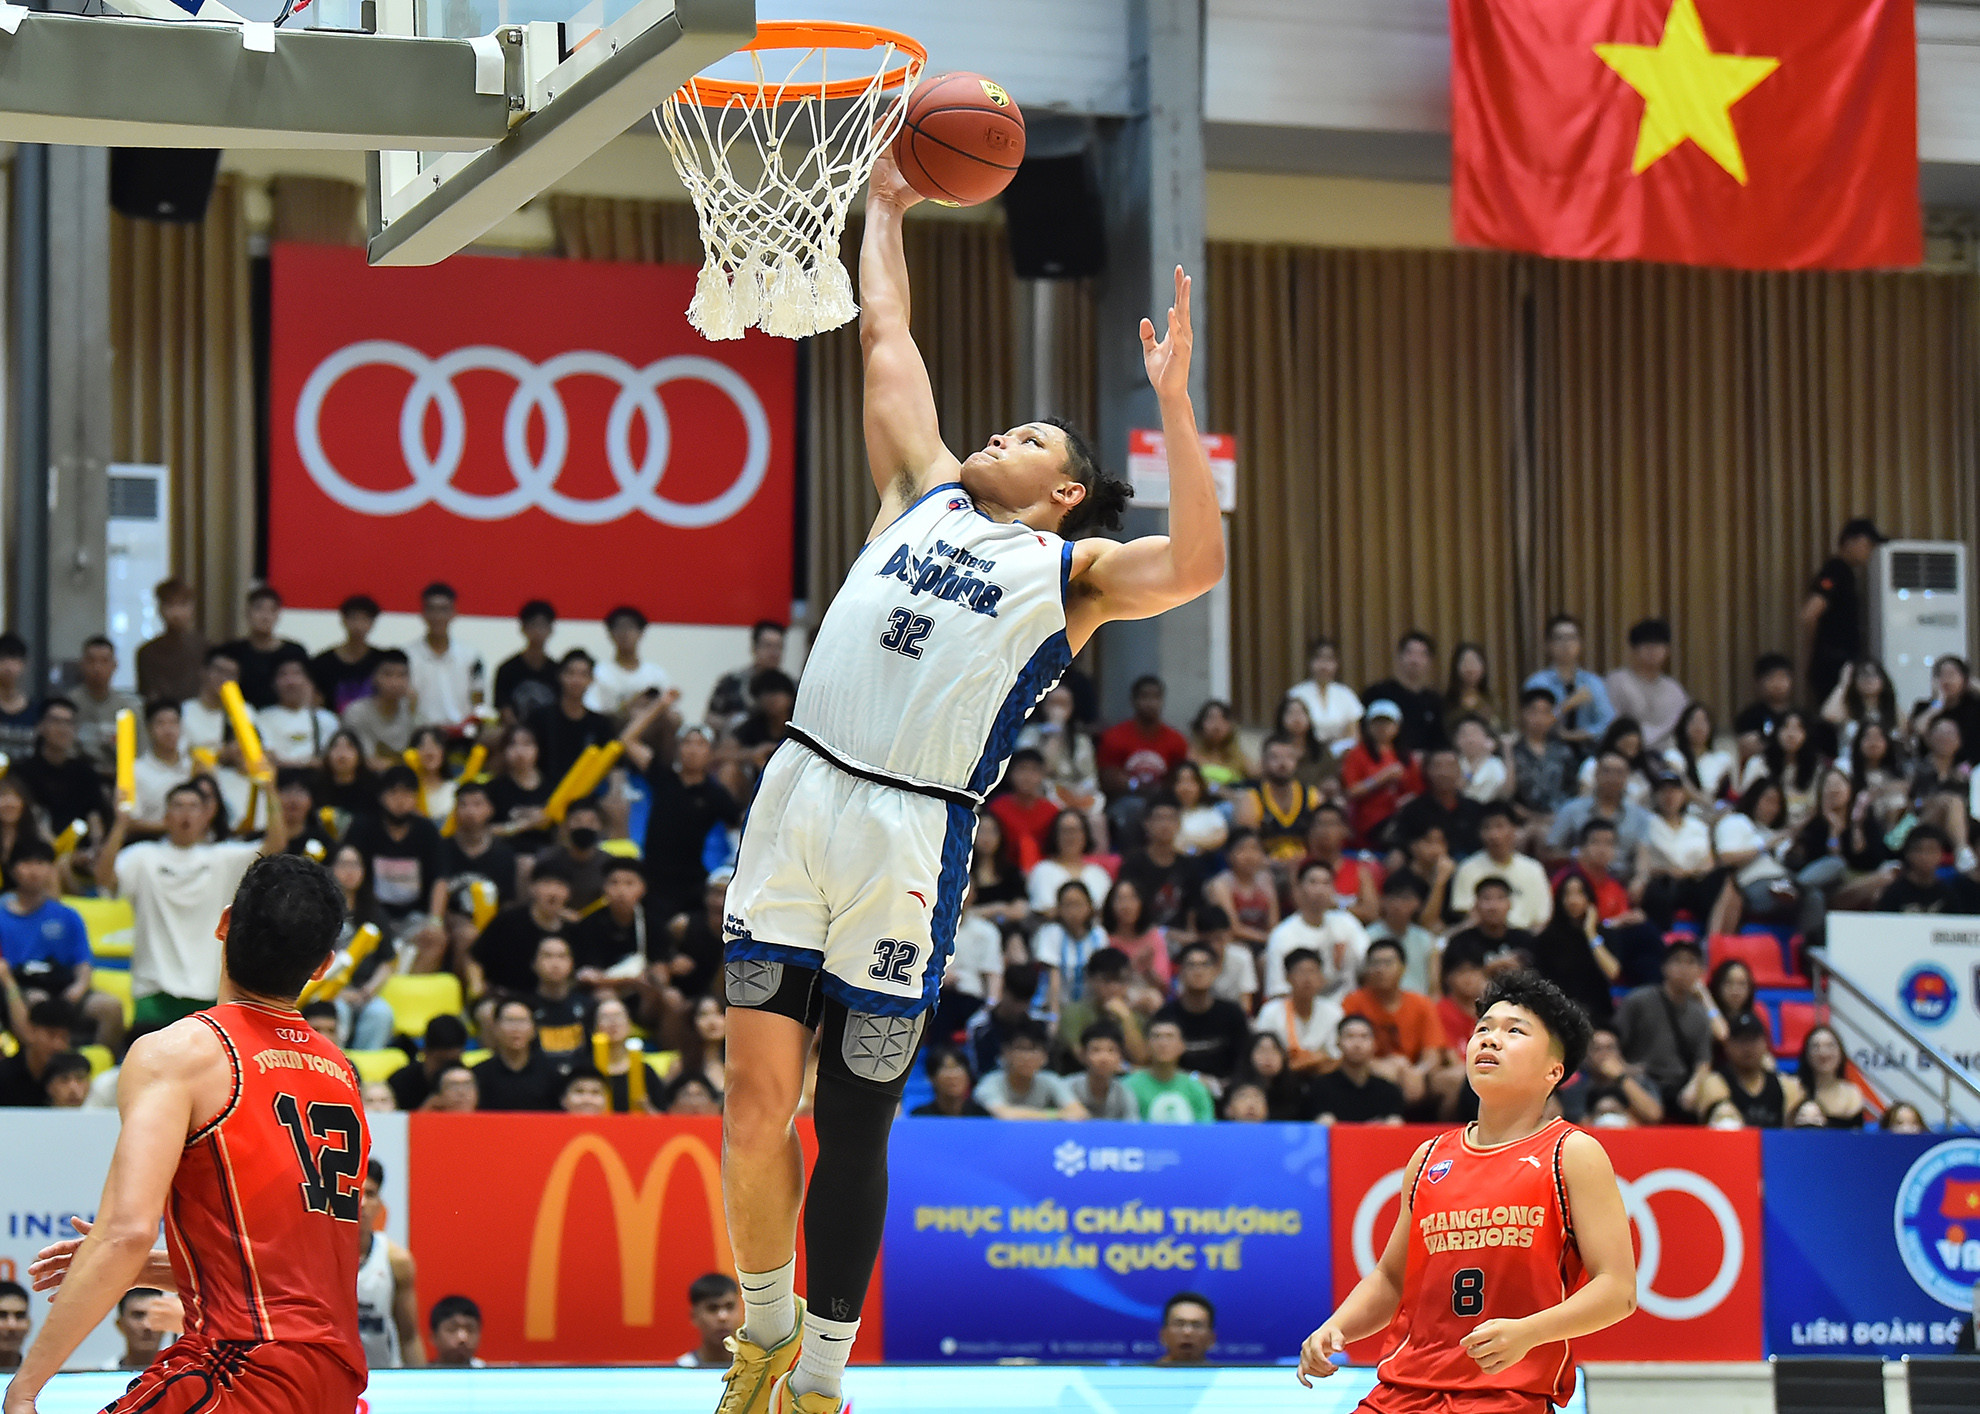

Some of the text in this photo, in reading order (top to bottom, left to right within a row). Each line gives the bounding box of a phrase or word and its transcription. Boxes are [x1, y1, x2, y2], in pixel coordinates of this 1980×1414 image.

[879, 606, 936, 660] 32
[868, 938, 920, 986] 32
[273, 1092, 362, 1223] 12
[915, 1207, 1003, 1238] PHỤC
[1424, 1227, 1535, 1255] WARRIORS
[1453, 1267, 1485, 1318] 8
[1791, 1316, 1848, 1346] LIÊN
